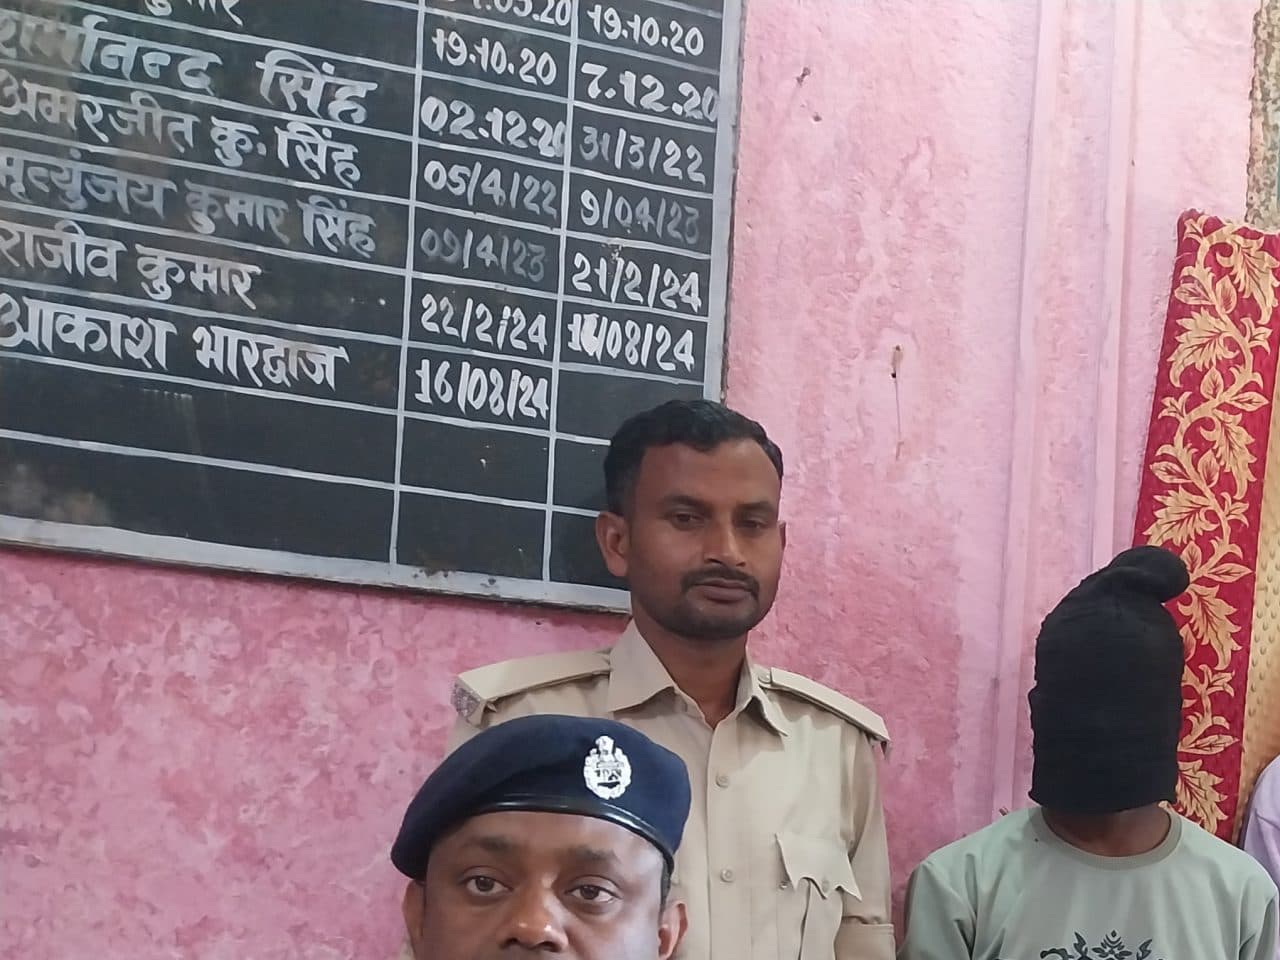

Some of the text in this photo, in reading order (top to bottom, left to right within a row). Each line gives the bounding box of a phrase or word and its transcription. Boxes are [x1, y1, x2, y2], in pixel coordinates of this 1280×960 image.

[431, 28, 557, 86] 19.10.20
[586, 4, 704, 56] 19.10.20
[255, 50, 378, 124] सिंह
[581, 62, 718, 122] 7.12.20
[0, 69, 200, 153] अमरजीत
[274, 120, 361, 189] सिंह
[184, 178, 290, 245] कुमार
[296, 194, 376, 258] सिंह
[0, 219, 262, 310] राजीव कुमार
[571, 252, 702, 313] 21/2/24
[0, 292, 178, 371] आकाश
[414, 358, 550, 421] 16/08/24
